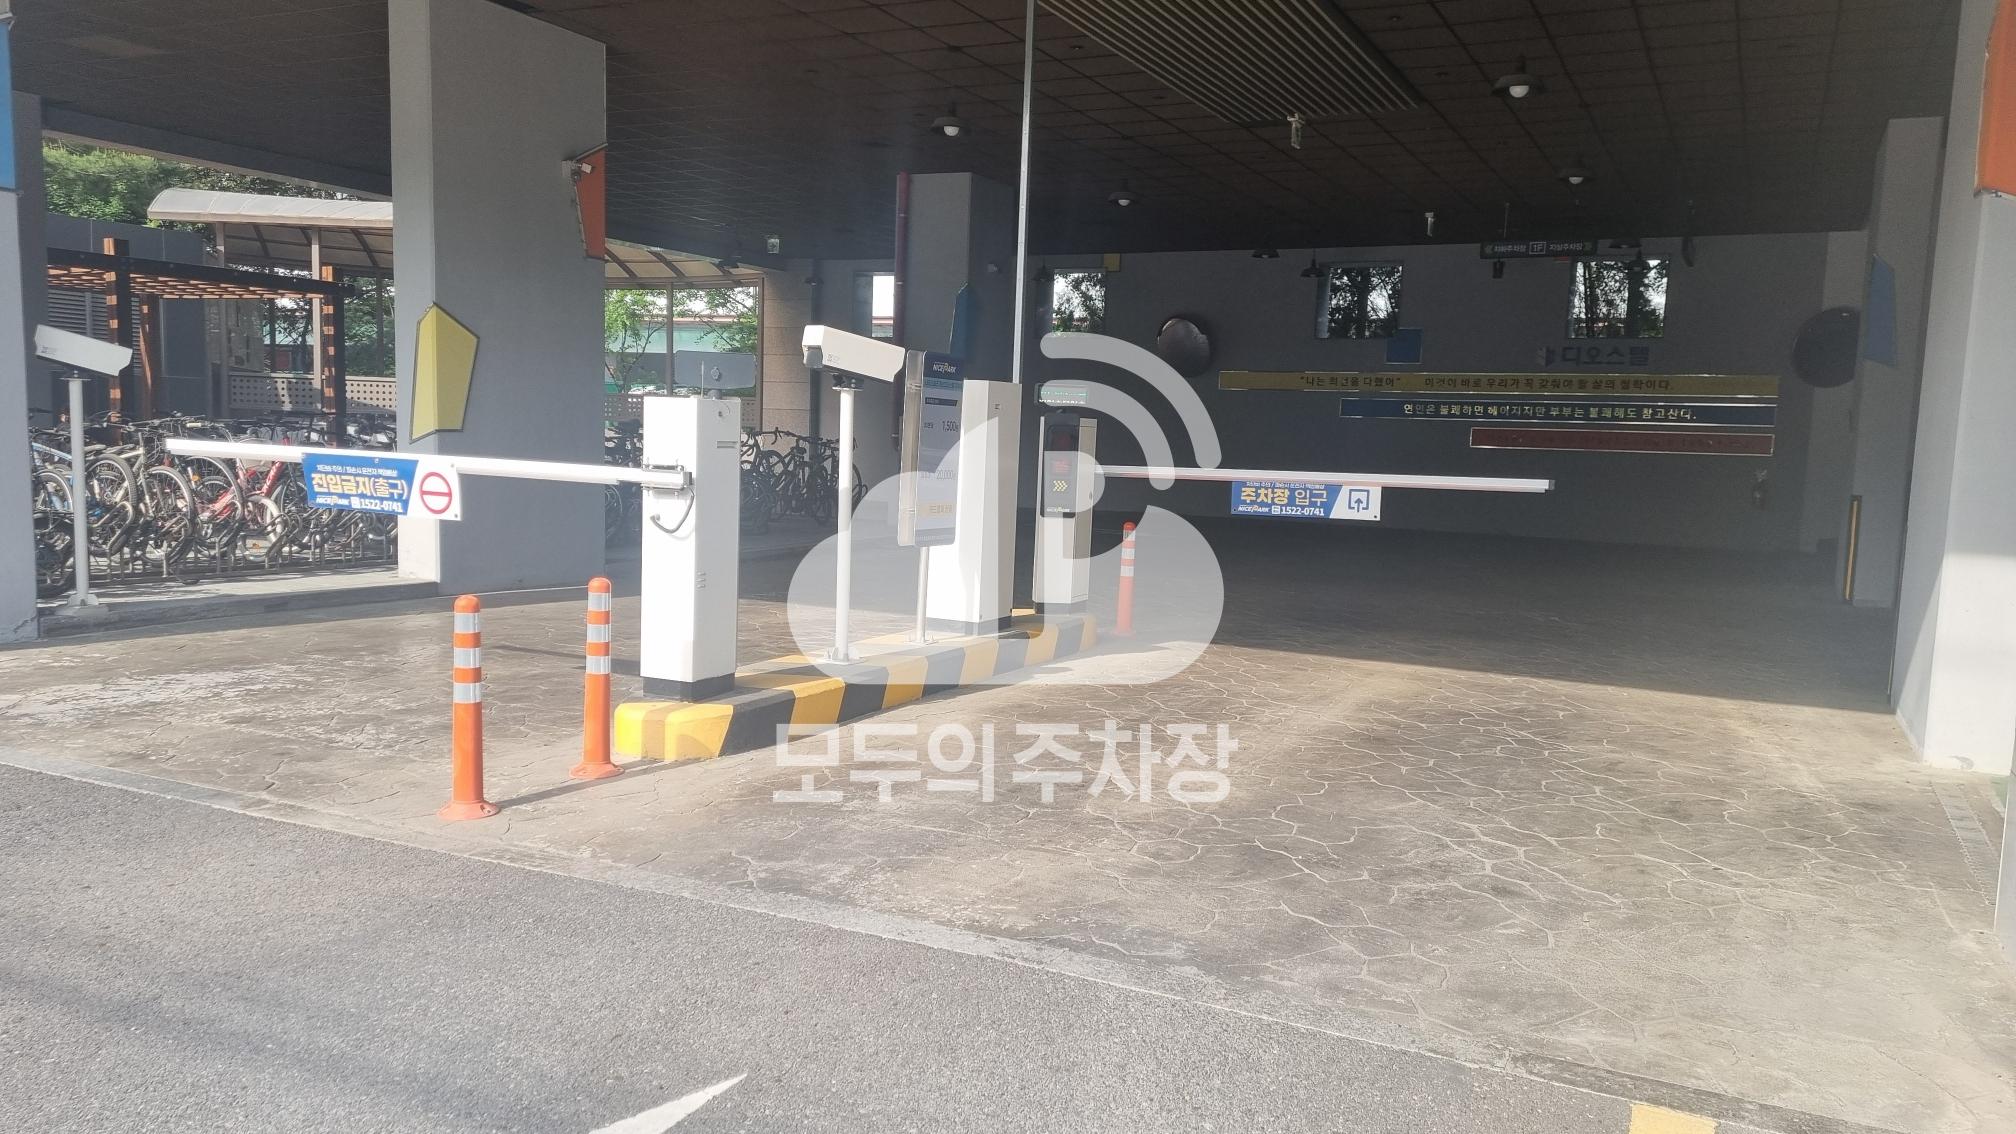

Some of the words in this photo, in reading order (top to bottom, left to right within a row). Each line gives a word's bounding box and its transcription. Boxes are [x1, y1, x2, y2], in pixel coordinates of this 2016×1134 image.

[1424, 378, 1457, 388] 이것이
[1460, 378, 1481, 388] 바로
[1486, 378, 1520, 389] 우리가
[1403, 404, 1436, 415] 연인은
[1440, 404, 1484, 416] 불쾌하면
[1487, 405, 1546, 417] 헤어지지만
[1549, 406, 1585, 418] 부부는
[1589, 407, 1637, 419] 불쾌해도
[311, 473, 408, 500] 진입금지(출구)
[1240, 487, 1290, 505] 주차장
[1294, 489, 1328, 507] 입구
[360, 498, 403, 513] 1522-0741
[1238, 504, 1270, 513] NICEPARK
[1281, 506, 1325, 516] 1522-0741
